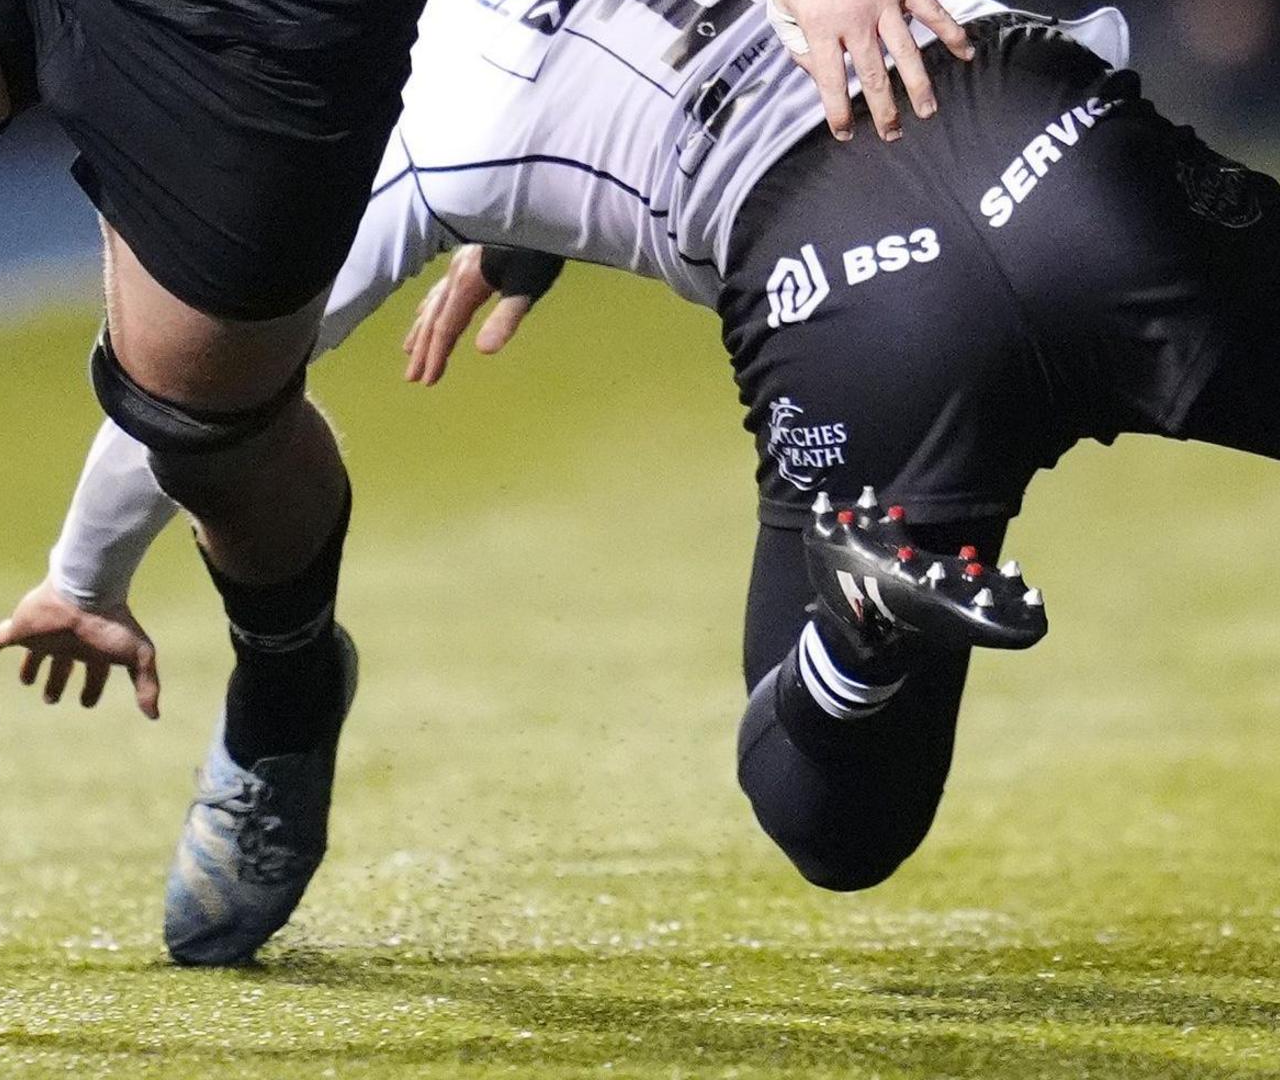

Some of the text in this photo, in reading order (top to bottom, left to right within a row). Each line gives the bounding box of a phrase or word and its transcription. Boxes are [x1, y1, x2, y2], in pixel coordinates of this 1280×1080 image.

[842, 95, 1124, 287] BS3 SERVIC
[791, 446, 845, 468] BATH
